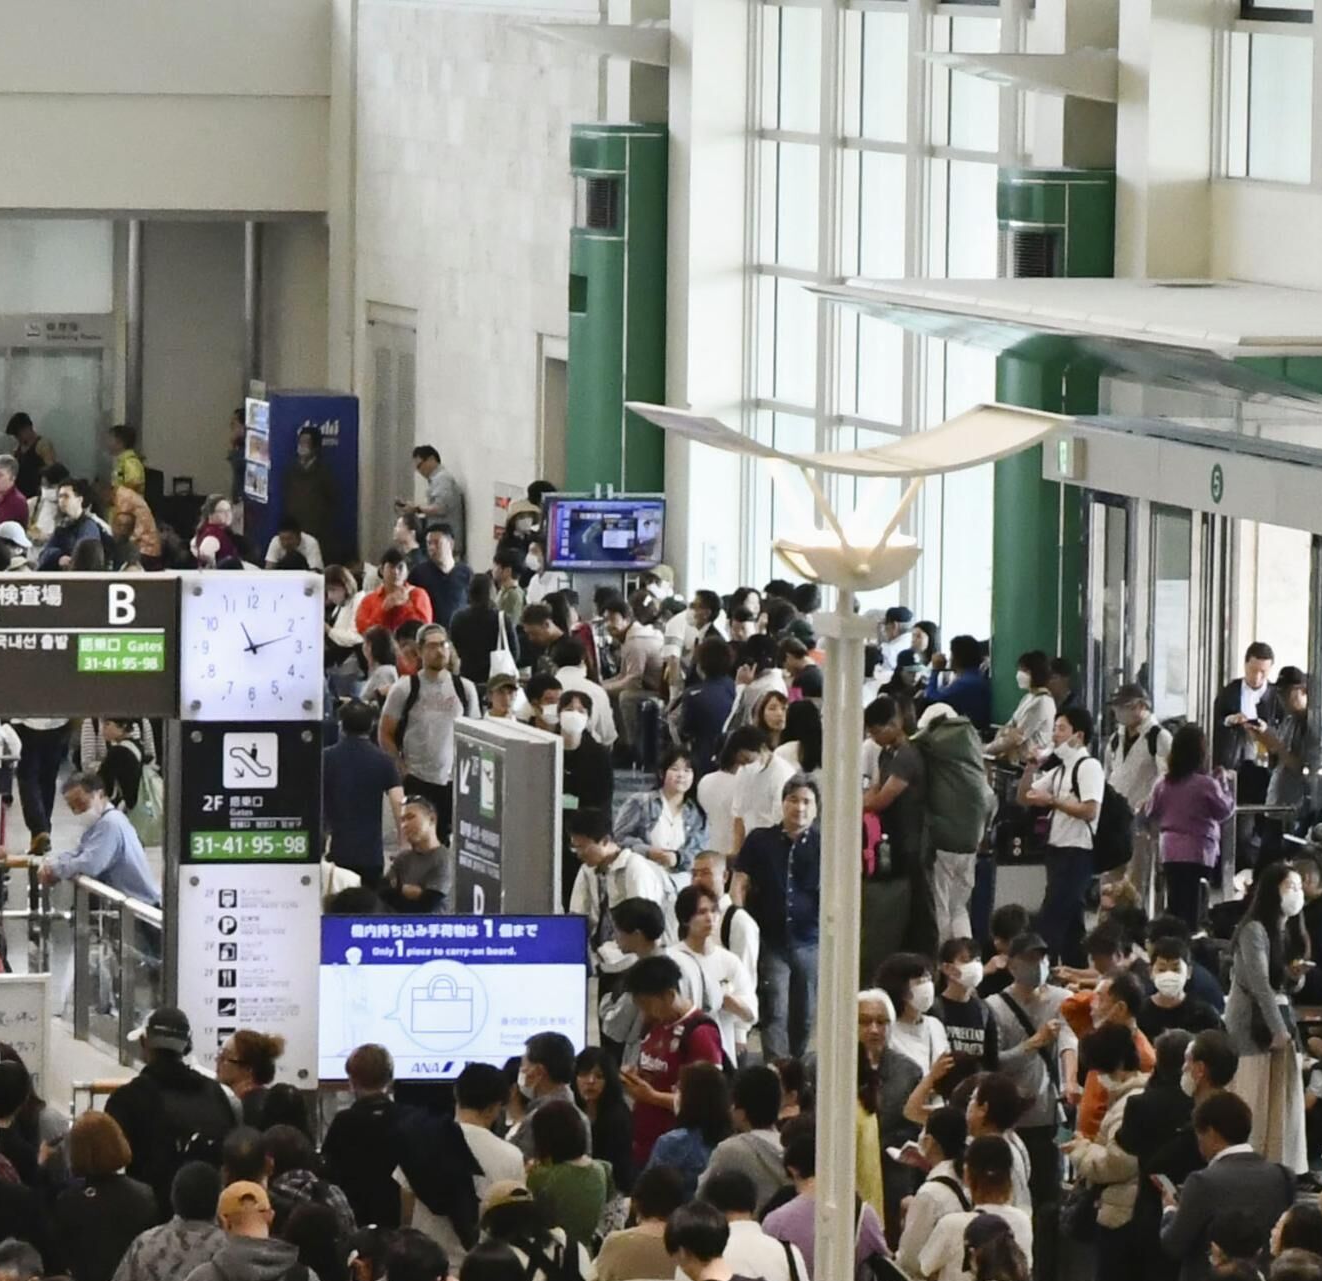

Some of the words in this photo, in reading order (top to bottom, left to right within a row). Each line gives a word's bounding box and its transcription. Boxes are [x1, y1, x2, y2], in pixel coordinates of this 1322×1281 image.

[107, 584, 136, 625] B
[247, 595, 259, 609] 12
[207, 617, 219, 631] 10
[287, 618, 295, 633] 2
[128, 640, 163, 653] Gates
[202, 640, 209, 655] 9
[295, 640, 303, 654] 3
[208, 664, 216, 678] 8
[287, 664, 295, 677] 4
[248, 686, 256, 701] 6
[271, 681, 279, 696] 5
[202, 795, 224, 812] 2F
[473, 884, 485, 915] D
[351, 923, 479, 939] 機内持ち込み手荷物は
[483, 919, 494, 938] 1
[499, 923, 539, 938] 個まで
[372, 946, 395, 958] Only
[395, 940, 405, 958] 1
[406, 946, 432, 957] piece
[433, 946, 444, 956] to
[486, 946, 517, 956] board.
[411, 1062, 439, 1073] ANA
